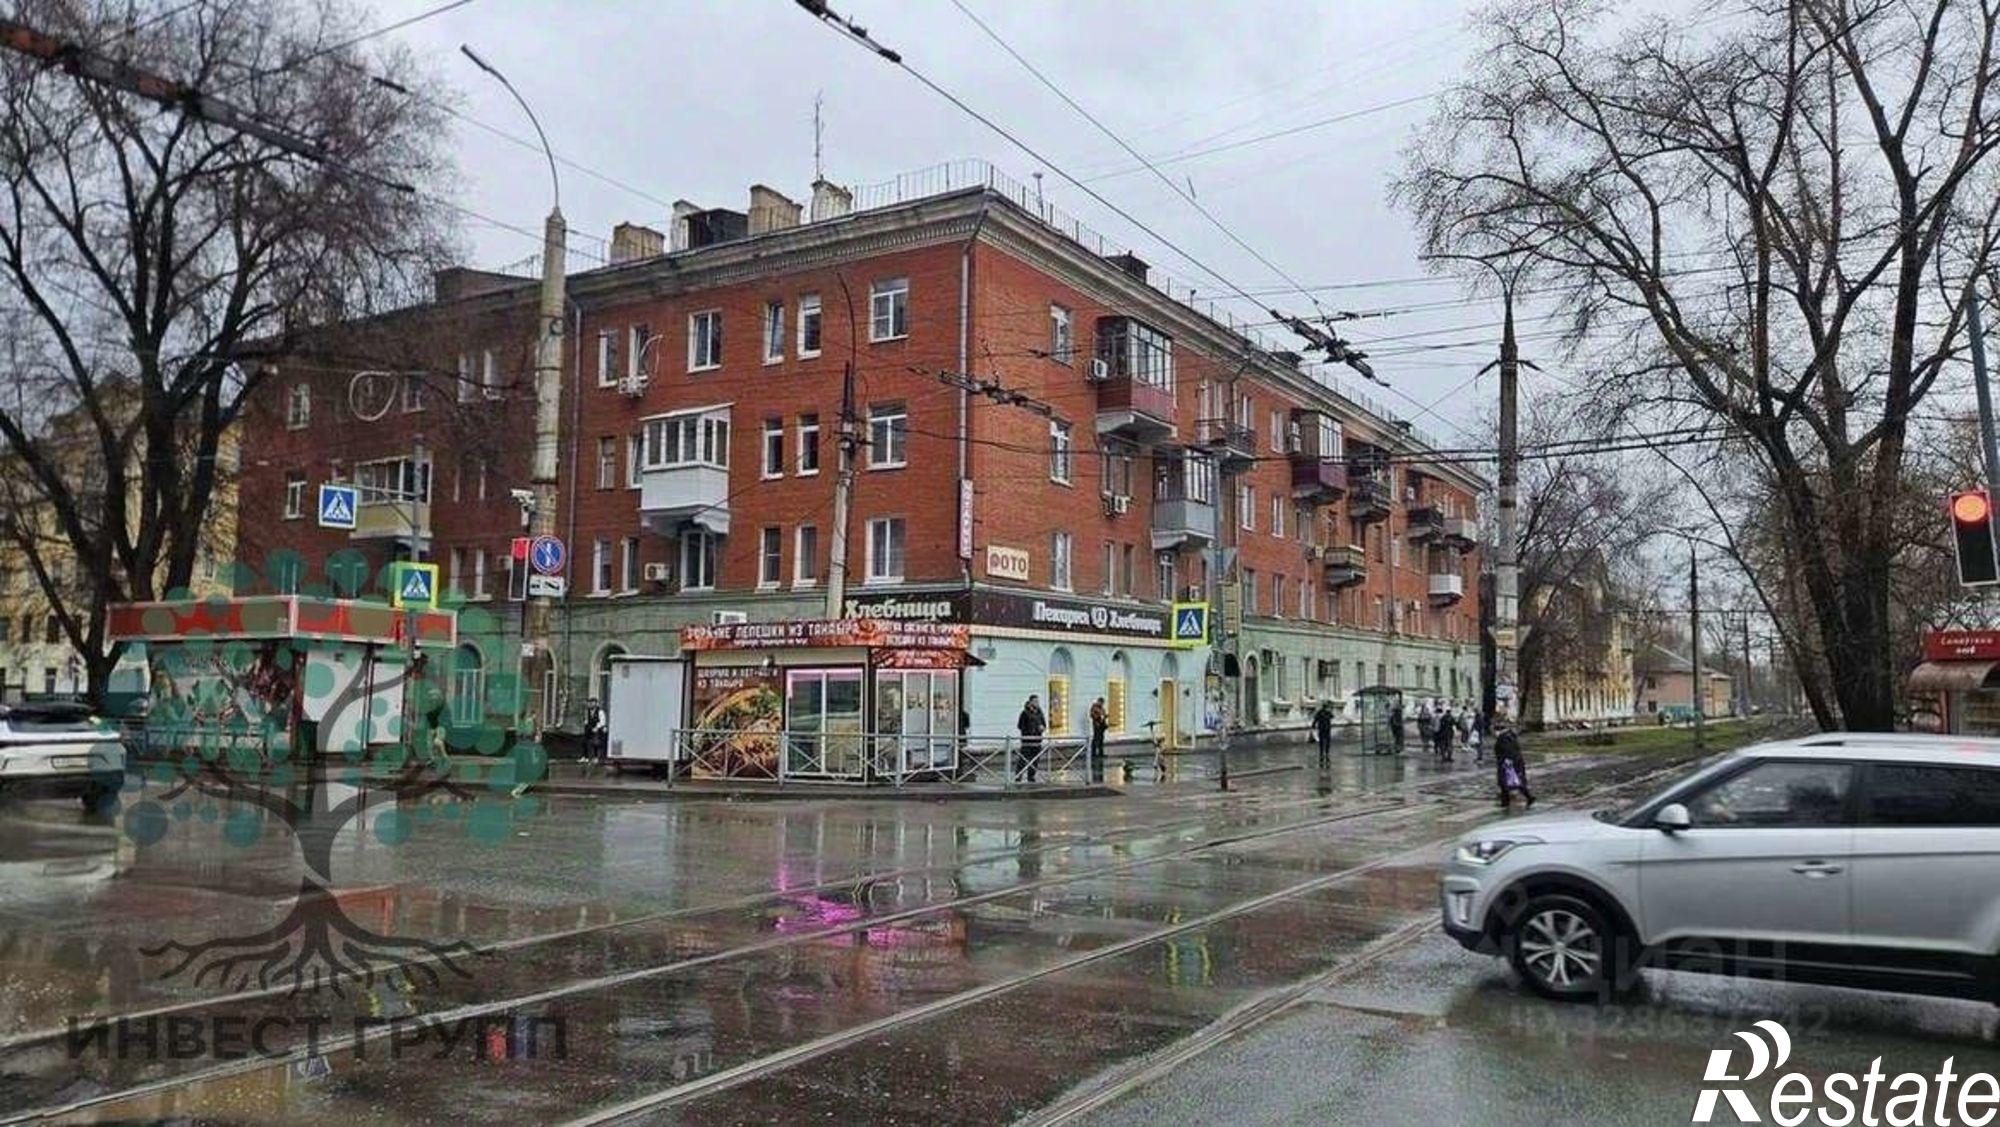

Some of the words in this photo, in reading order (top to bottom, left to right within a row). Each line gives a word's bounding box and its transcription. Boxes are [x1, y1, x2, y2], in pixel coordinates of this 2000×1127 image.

[989, 552, 1027, 573] ФОТО
[845, 598, 952, 621] Хлебница
[1031, 600, 1091, 627] Пекарня
[1109, 608, 1162, 634] Хлебница
[788, 623, 803, 637] ИЗ
